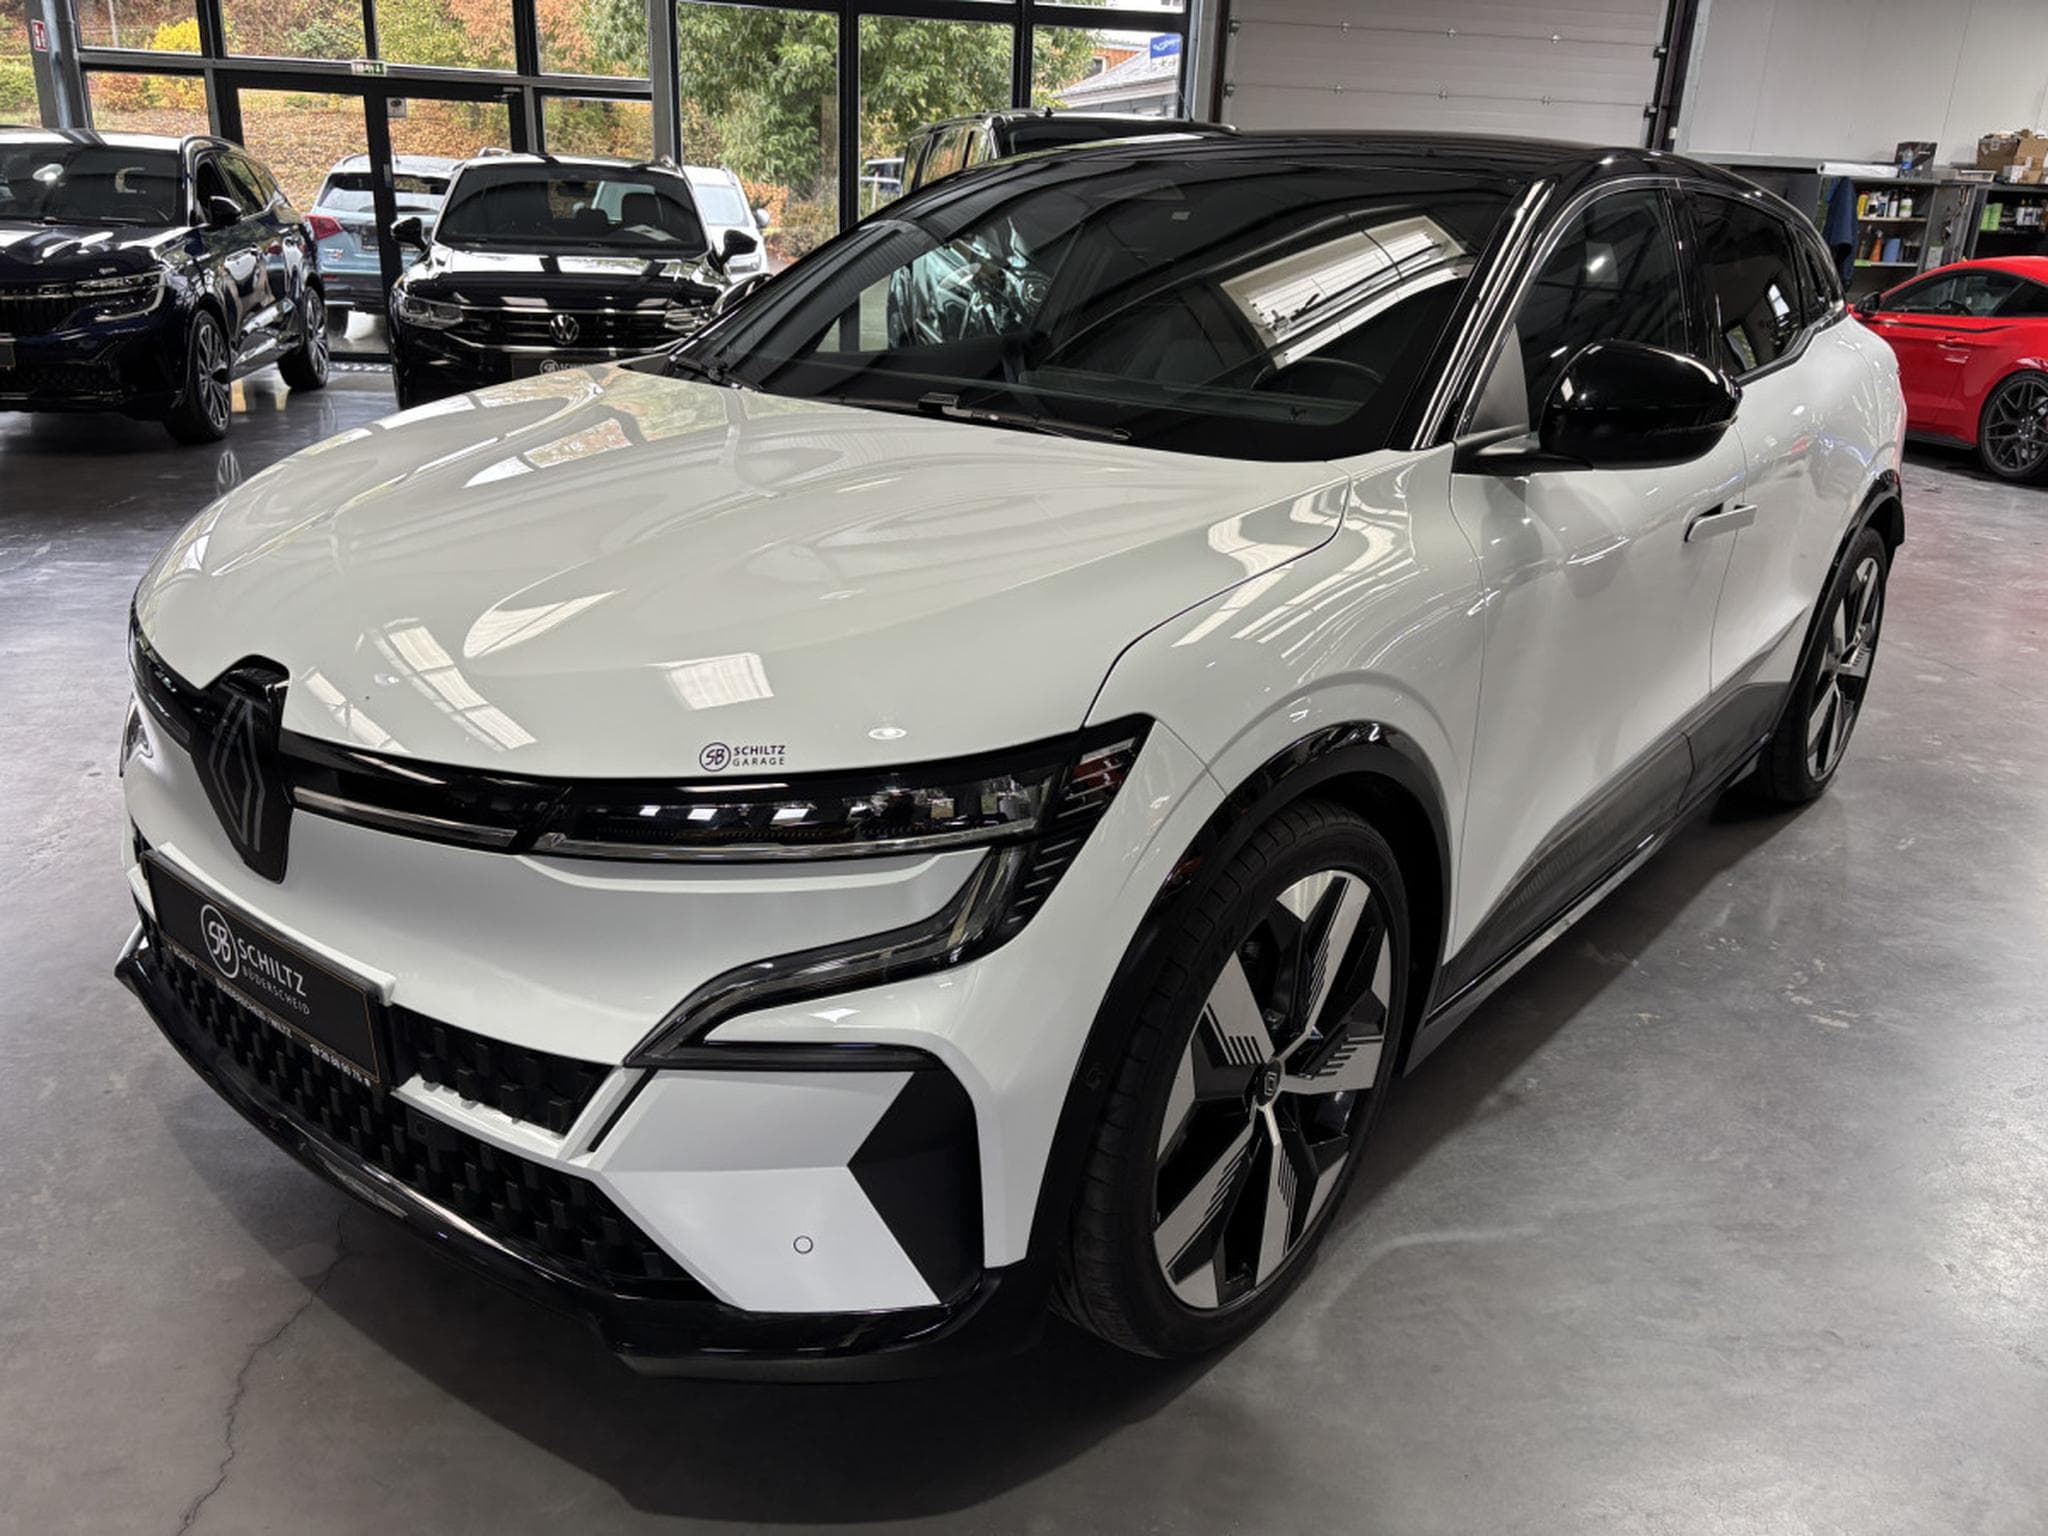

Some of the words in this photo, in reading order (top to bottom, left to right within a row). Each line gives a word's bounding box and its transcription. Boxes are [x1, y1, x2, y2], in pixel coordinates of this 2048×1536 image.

[733, 745, 786, 756] SCHILTZ
[732, 756, 785, 767] GARAGE
[238, 938, 307, 997] SCHILTZ
